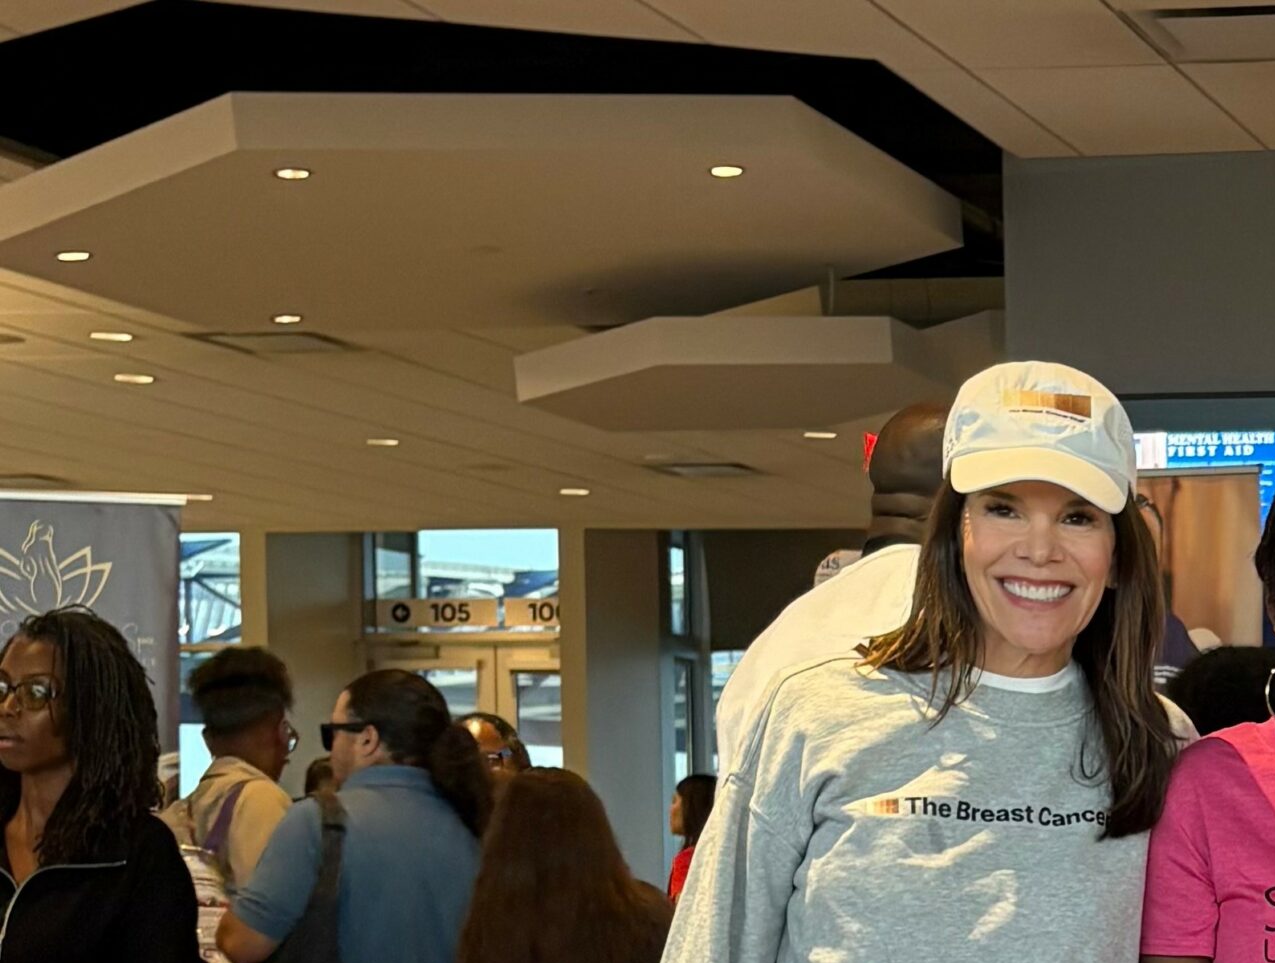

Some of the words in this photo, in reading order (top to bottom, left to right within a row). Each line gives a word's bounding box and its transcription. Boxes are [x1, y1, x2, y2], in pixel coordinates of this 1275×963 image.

[1167, 446, 1217, 457] FIRST
[1224, 445, 1255, 456] AID
[431, 603, 471, 622] 105
[904, 797, 951, 818] The
[956, 801, 1034, 824] Breast
[1038, 806, 1110, 827] Cance
